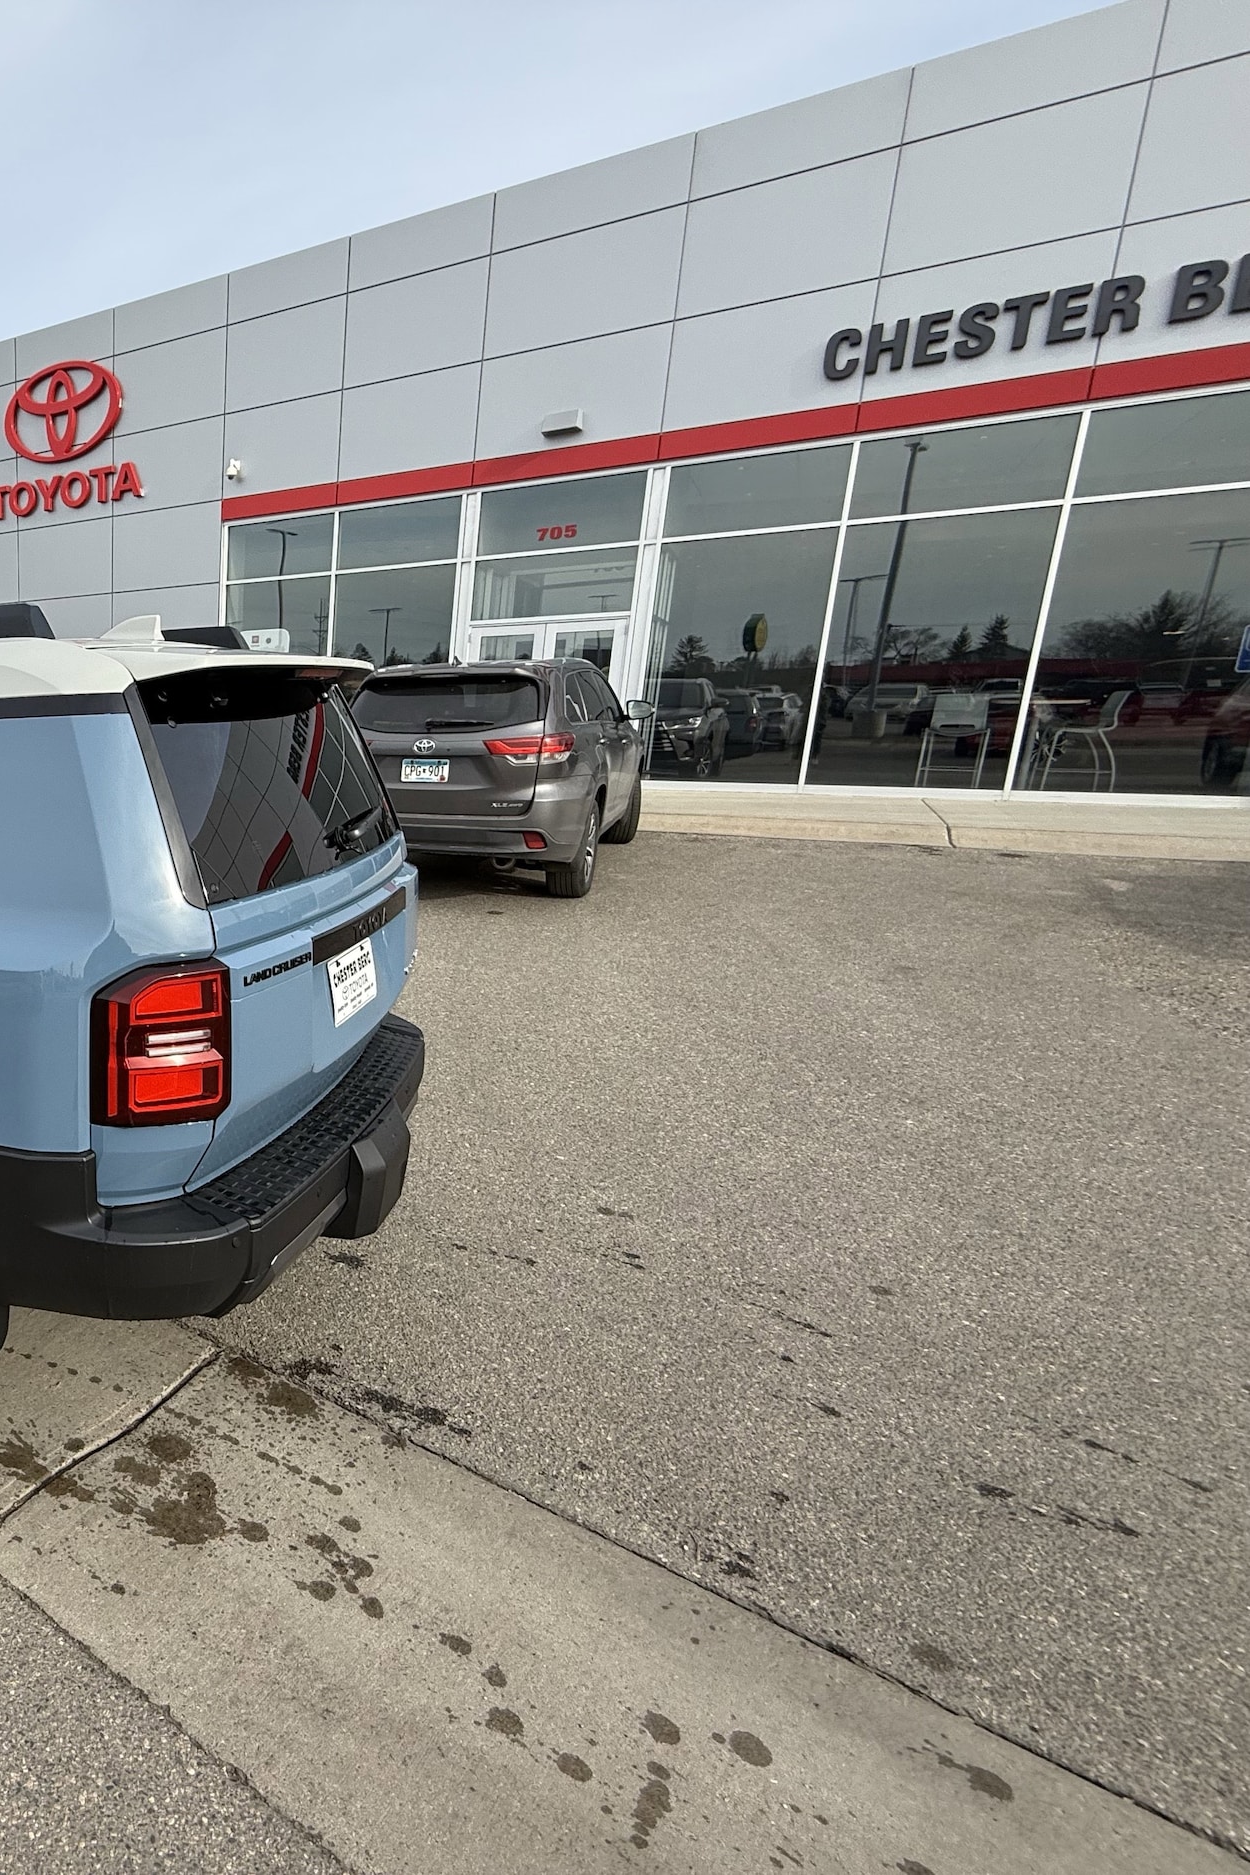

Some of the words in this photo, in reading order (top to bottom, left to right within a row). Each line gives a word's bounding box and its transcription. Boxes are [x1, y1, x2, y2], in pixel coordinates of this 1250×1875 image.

[823, 274, 1146, 381] CHESTER
[536, 524, 577, 541] 705
[405, 765, 421, 776] CPG
[428, 765, 444, 776] 901
[353, 906, 387, 941] TOYOTA
[243, 967, 272, 987] LAND
[272, 951, 312, 977] CRUISER
[333, 960, 357, 988] CHESTER
[349, 973, 368, 993] TOYOTA
